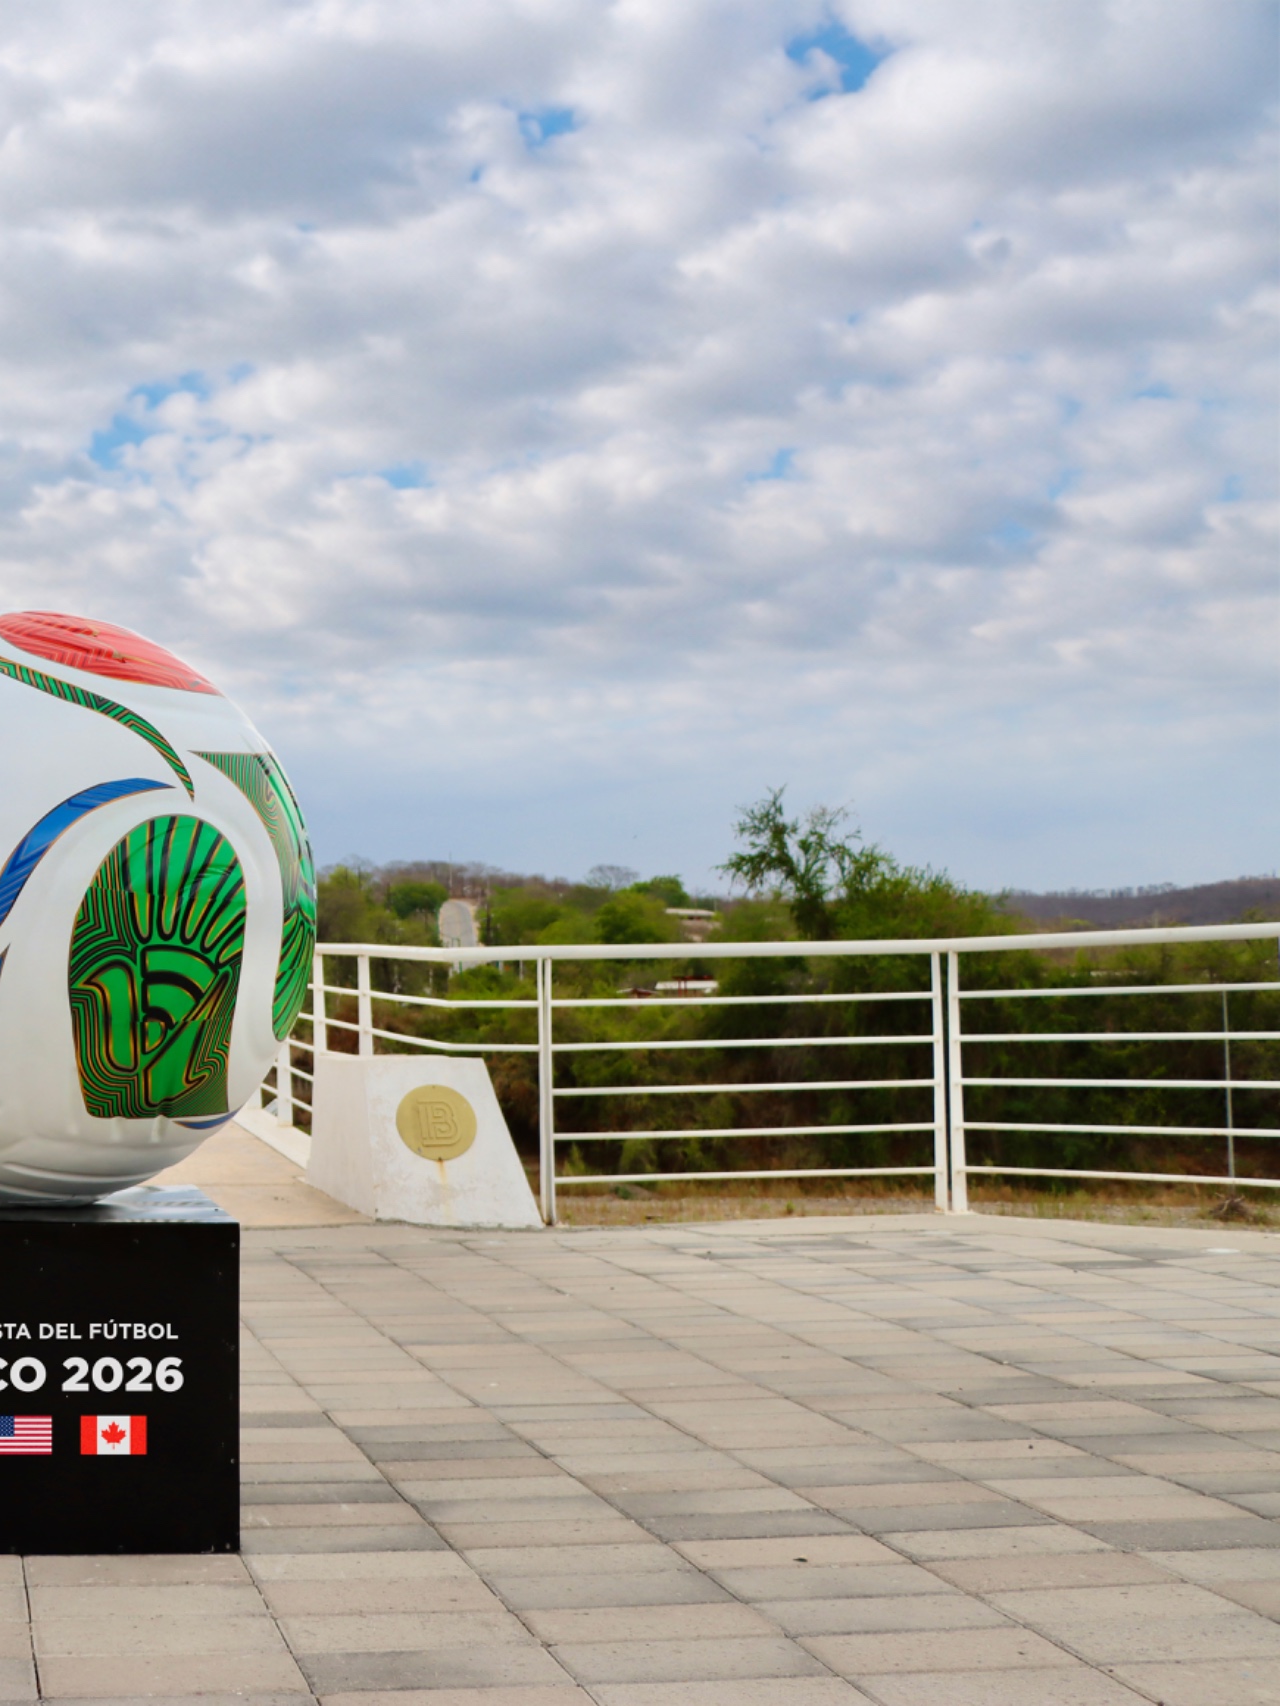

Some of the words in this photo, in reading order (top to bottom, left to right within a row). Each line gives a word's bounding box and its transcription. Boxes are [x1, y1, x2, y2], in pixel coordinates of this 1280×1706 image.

[40, 1323, 82, 1340] DEL
[90, 1319, 179, 1340] FÚTBOL
[61, 1356, 185, 1393] 2026
